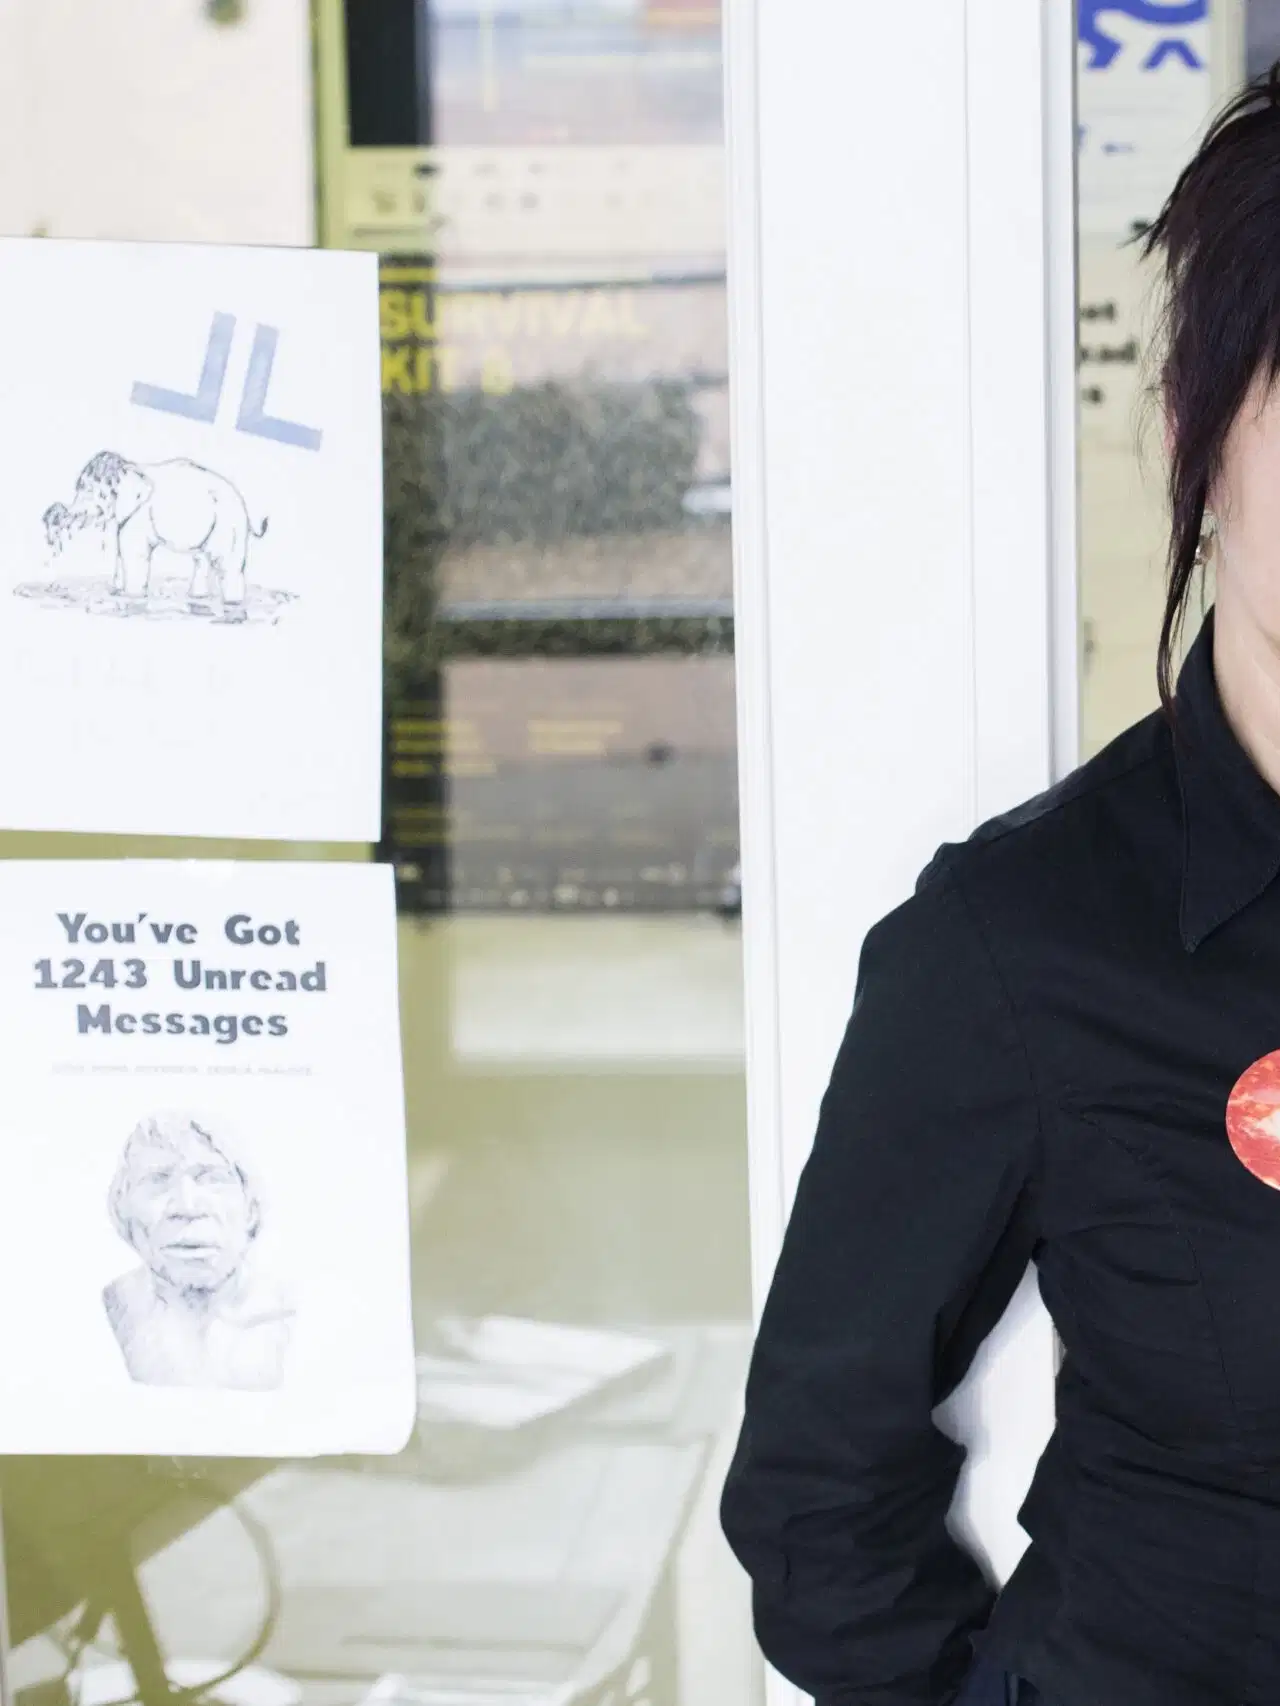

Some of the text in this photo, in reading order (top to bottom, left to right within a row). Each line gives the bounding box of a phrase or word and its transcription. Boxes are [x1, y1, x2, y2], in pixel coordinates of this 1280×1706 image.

[379, 292, 648, 339] SURVIVAL
[380, 345, 460, 395] KIT
[57, 912, 301, 946] You've Got
[34, 958, 327, 992] 1243 Unread
[77, 1003, 289, 1045] Messages
